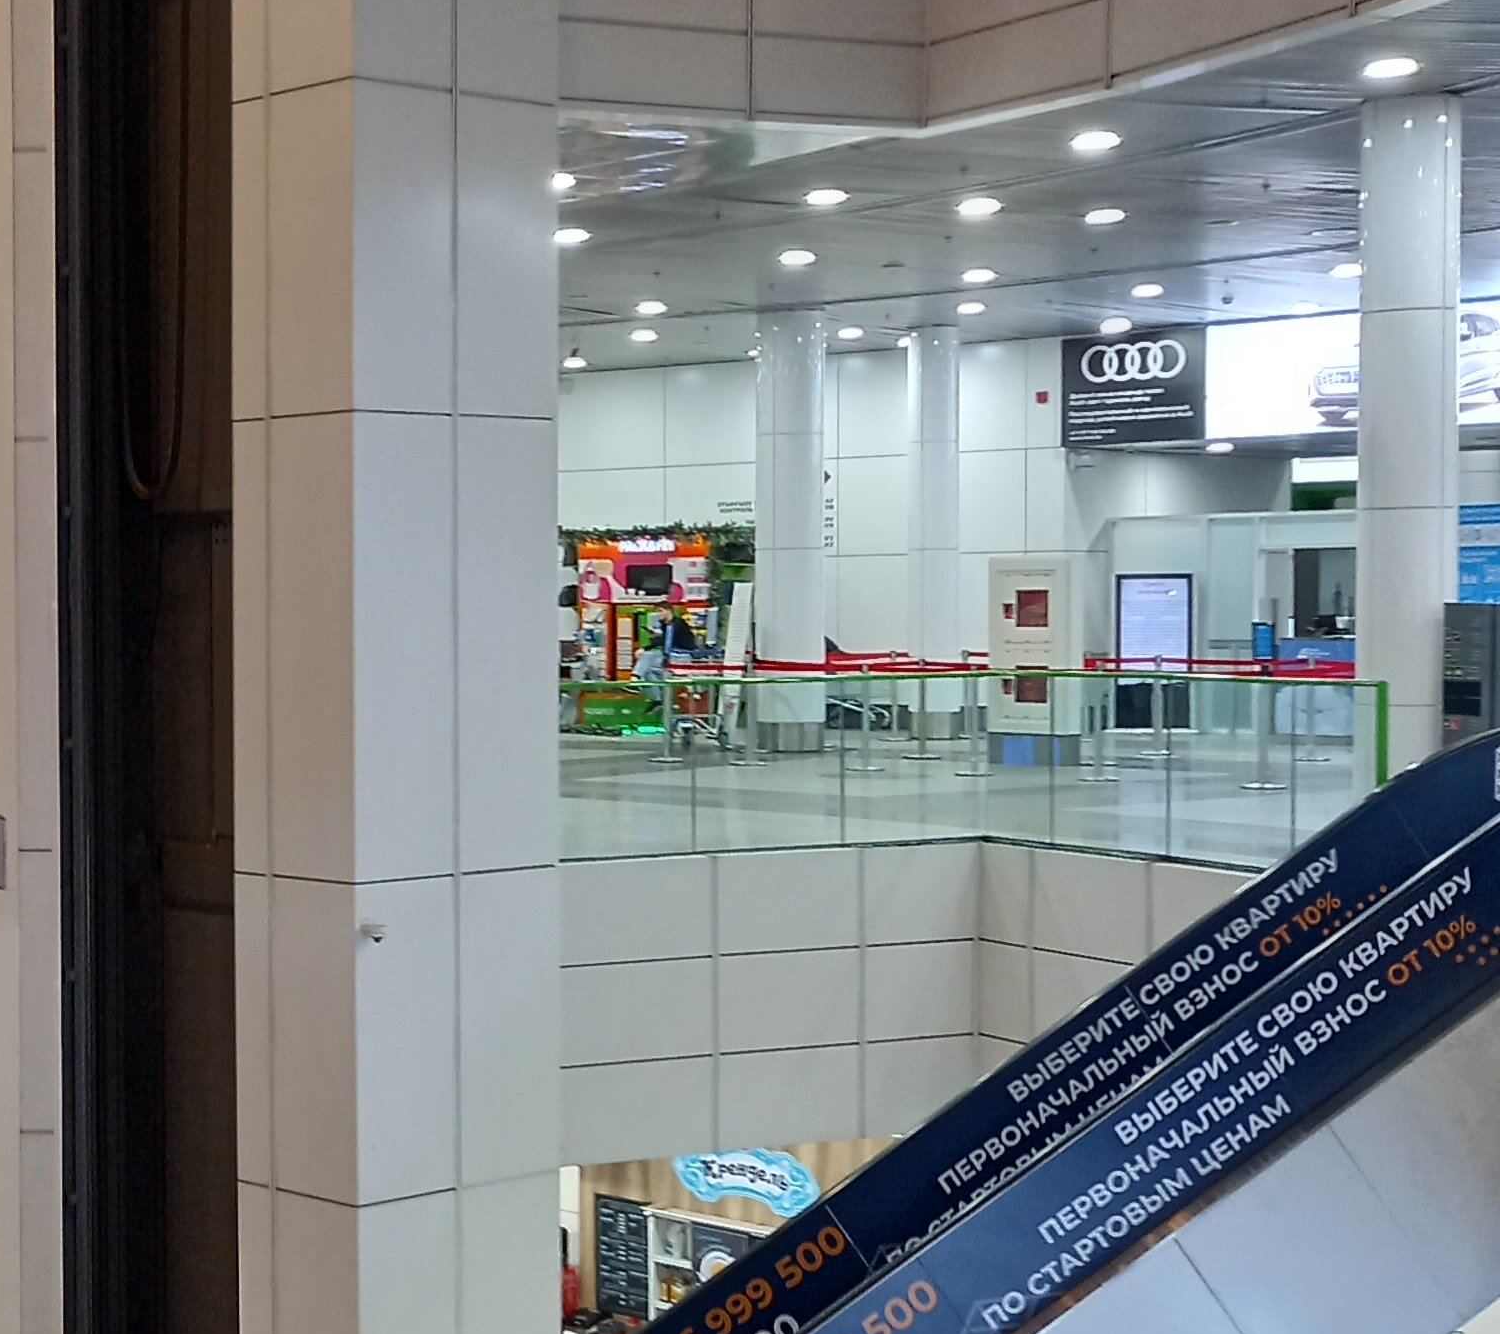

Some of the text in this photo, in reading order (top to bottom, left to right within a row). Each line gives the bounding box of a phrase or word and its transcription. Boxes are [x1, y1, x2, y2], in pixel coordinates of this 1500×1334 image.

[936, 891, 1342, 1195] ПЕРВОНАЧАЛЬНЫЙ ВЗНОС ОТ 10%
[1006, 847, 1341, 1106] ВЫБЕРИТЕ СВОЮ КВАРТИРУ
[1037, 915, 1476, 1246] ПЕРВОНАЧАЛЬНЫЙ ВЗНОС ОТ 10%
[1113, 866, 1474, 1147] ВЫБЕРИТЕ СВОЮ КВАРТИРУ
[775, 1224, 847, 1289] 500
[981, 1093, 1293, 1331] ПО СТАРТОВЫМ ЦЕНАМ
